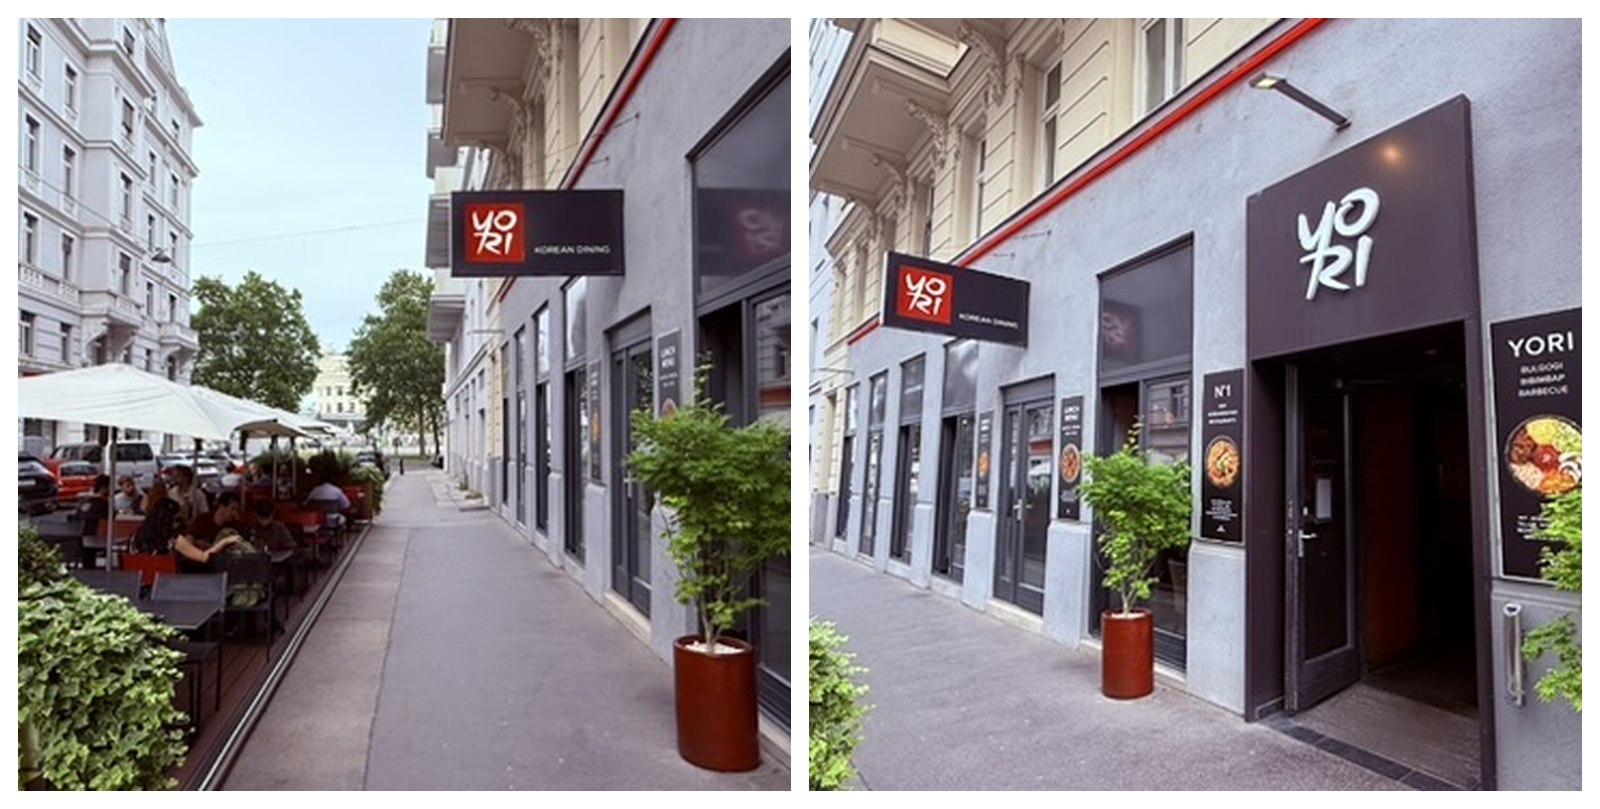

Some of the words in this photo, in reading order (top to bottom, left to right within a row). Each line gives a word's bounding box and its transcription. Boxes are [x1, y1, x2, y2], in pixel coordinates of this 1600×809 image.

[534, 245, 574, 255] KOREAN
[958, 313, 992, 324] KOREAN
[1508, 331, 1574, 358] YORI
[1520, 361, 1564, 374] BULGOGI
[1520, 373, 1566, 386] BIBIMBAP
